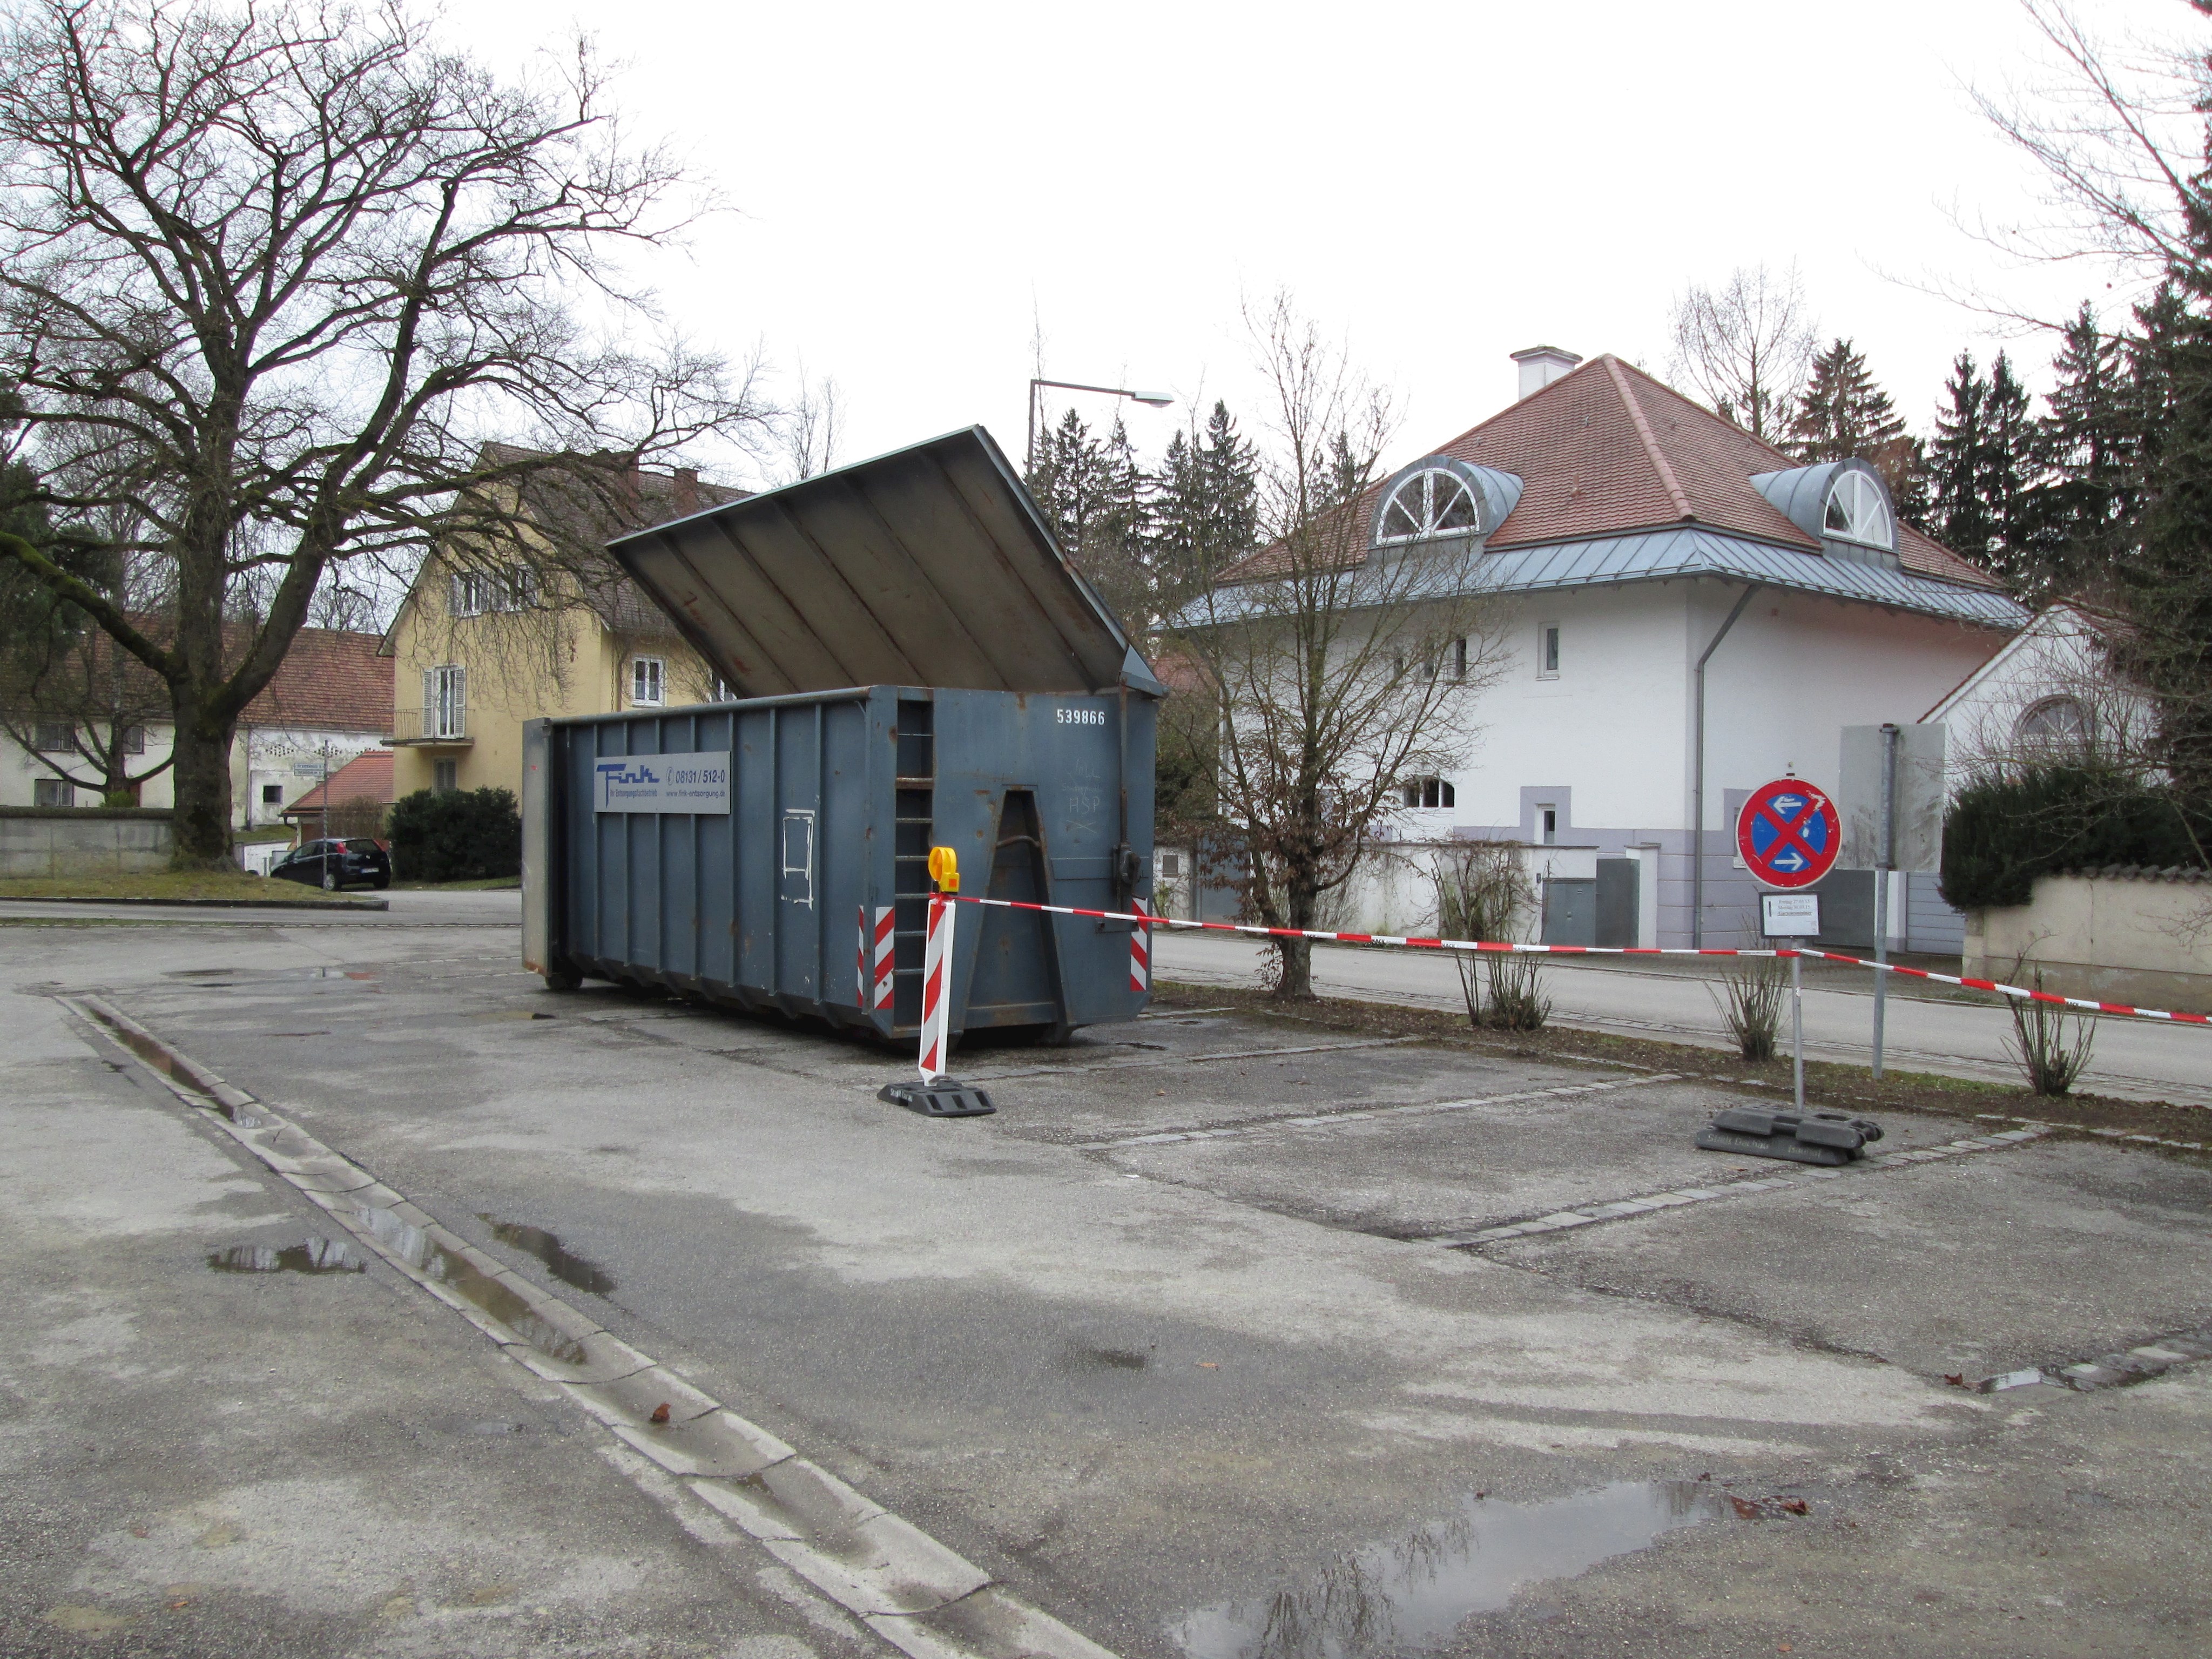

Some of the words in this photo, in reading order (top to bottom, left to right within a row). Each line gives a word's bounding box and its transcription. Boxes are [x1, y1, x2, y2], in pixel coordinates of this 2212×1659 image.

[1057, 709, 1105, 725] 539866
[676, 771, 697, 783] 08131
[703, 770, 725, 783] 512-0
[596, 763, 660, 808] Fink
[666, 790, 725, 799] www.fink-entsorgung.de
